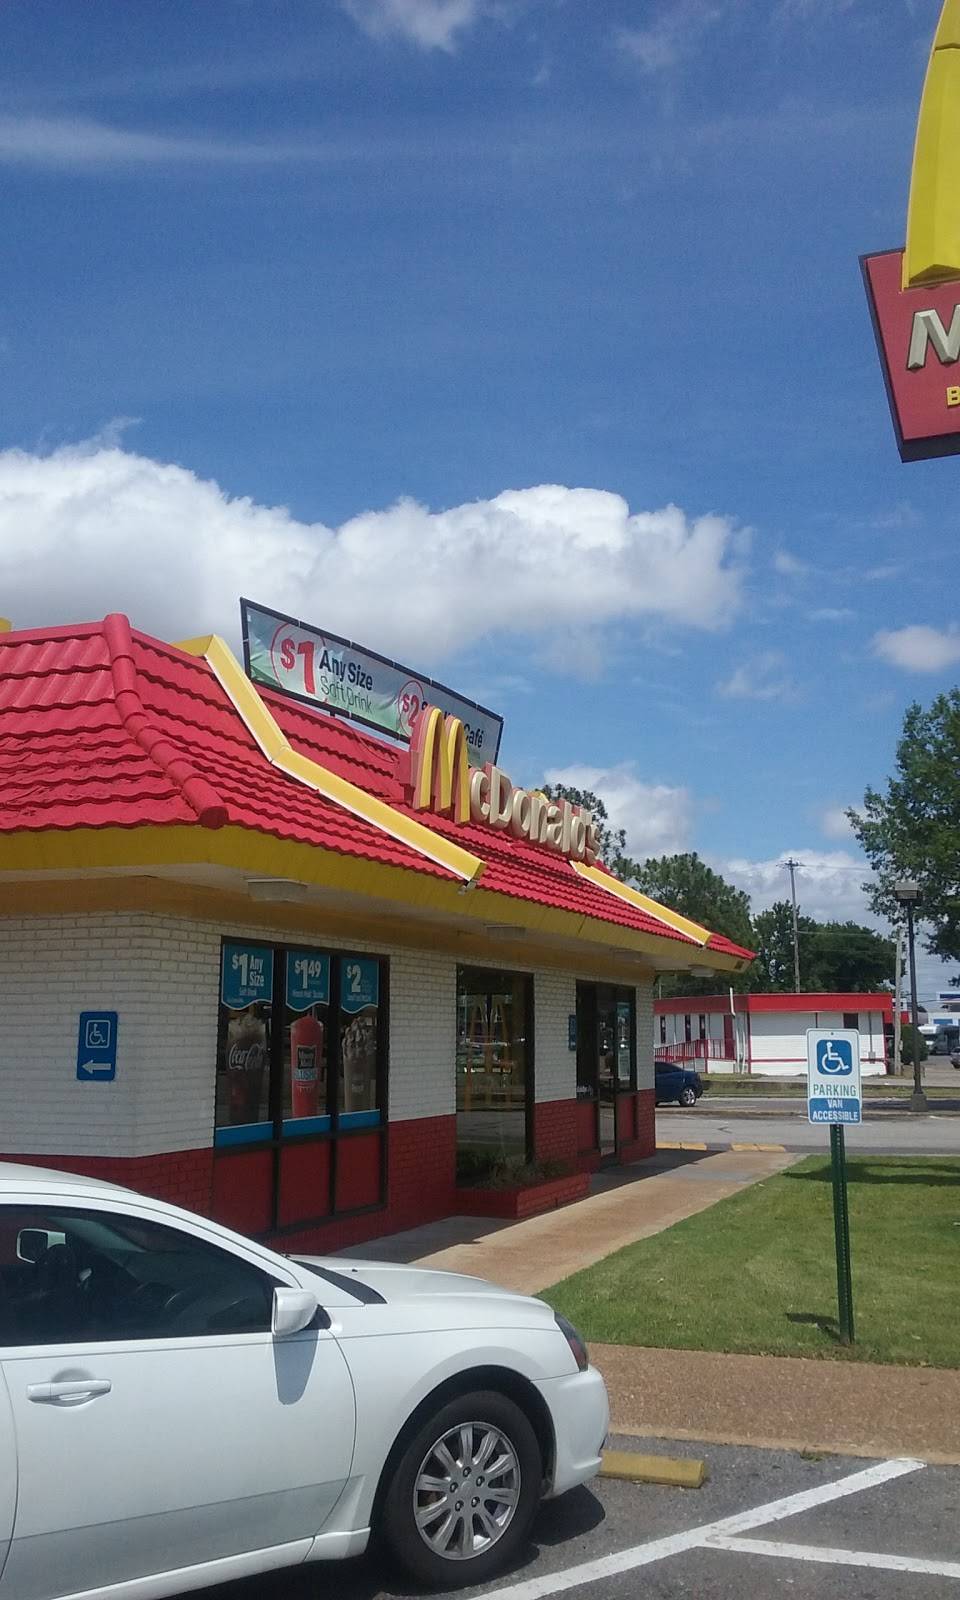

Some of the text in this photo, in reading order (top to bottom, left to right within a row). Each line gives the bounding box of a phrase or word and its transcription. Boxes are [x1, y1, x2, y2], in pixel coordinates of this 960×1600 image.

[280, 638, 315, 694] $1
[319, 650, 373, 691] Any Size
[320, 676, 372, 714] Soft Drink
[402, 694, 419, 727] $2
[412, 706, 600, 863] McDonald's
[232, 952, 248, 986] $1
[249, 971, 264, 987] Size
[250, 955, 264, 973] Any
[346, 964, 361, 992] $2
[813, 1084, 856, 1096] PARKING
[827, 1098, 843, 1108] VAN
[812, 1110, 858, 1120] ACCESSIBLE
